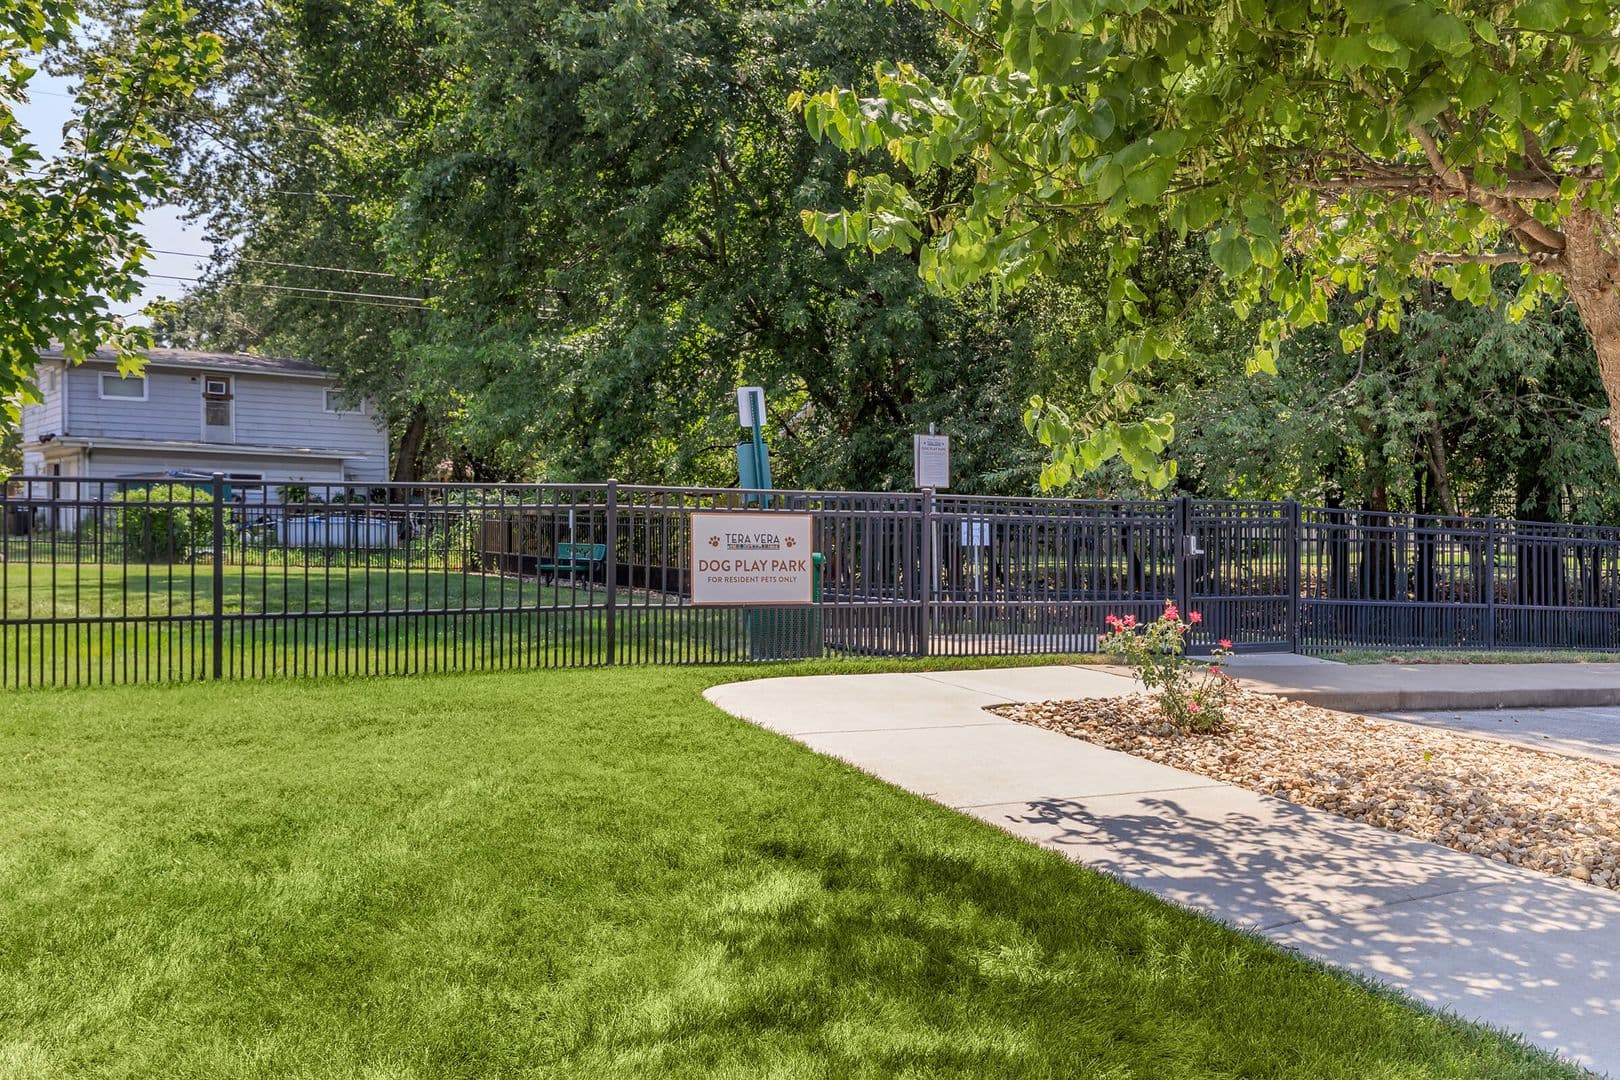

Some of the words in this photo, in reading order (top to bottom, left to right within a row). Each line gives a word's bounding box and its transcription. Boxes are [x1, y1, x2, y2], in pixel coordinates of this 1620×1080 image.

[725, 533, 751, 543] TERA
[754, 533, 780, 543] VERA
[699, 560, 730, 572] DOG
[735, 560, 768, 572] PLAY
[771, 560, 806, 572] PARK
